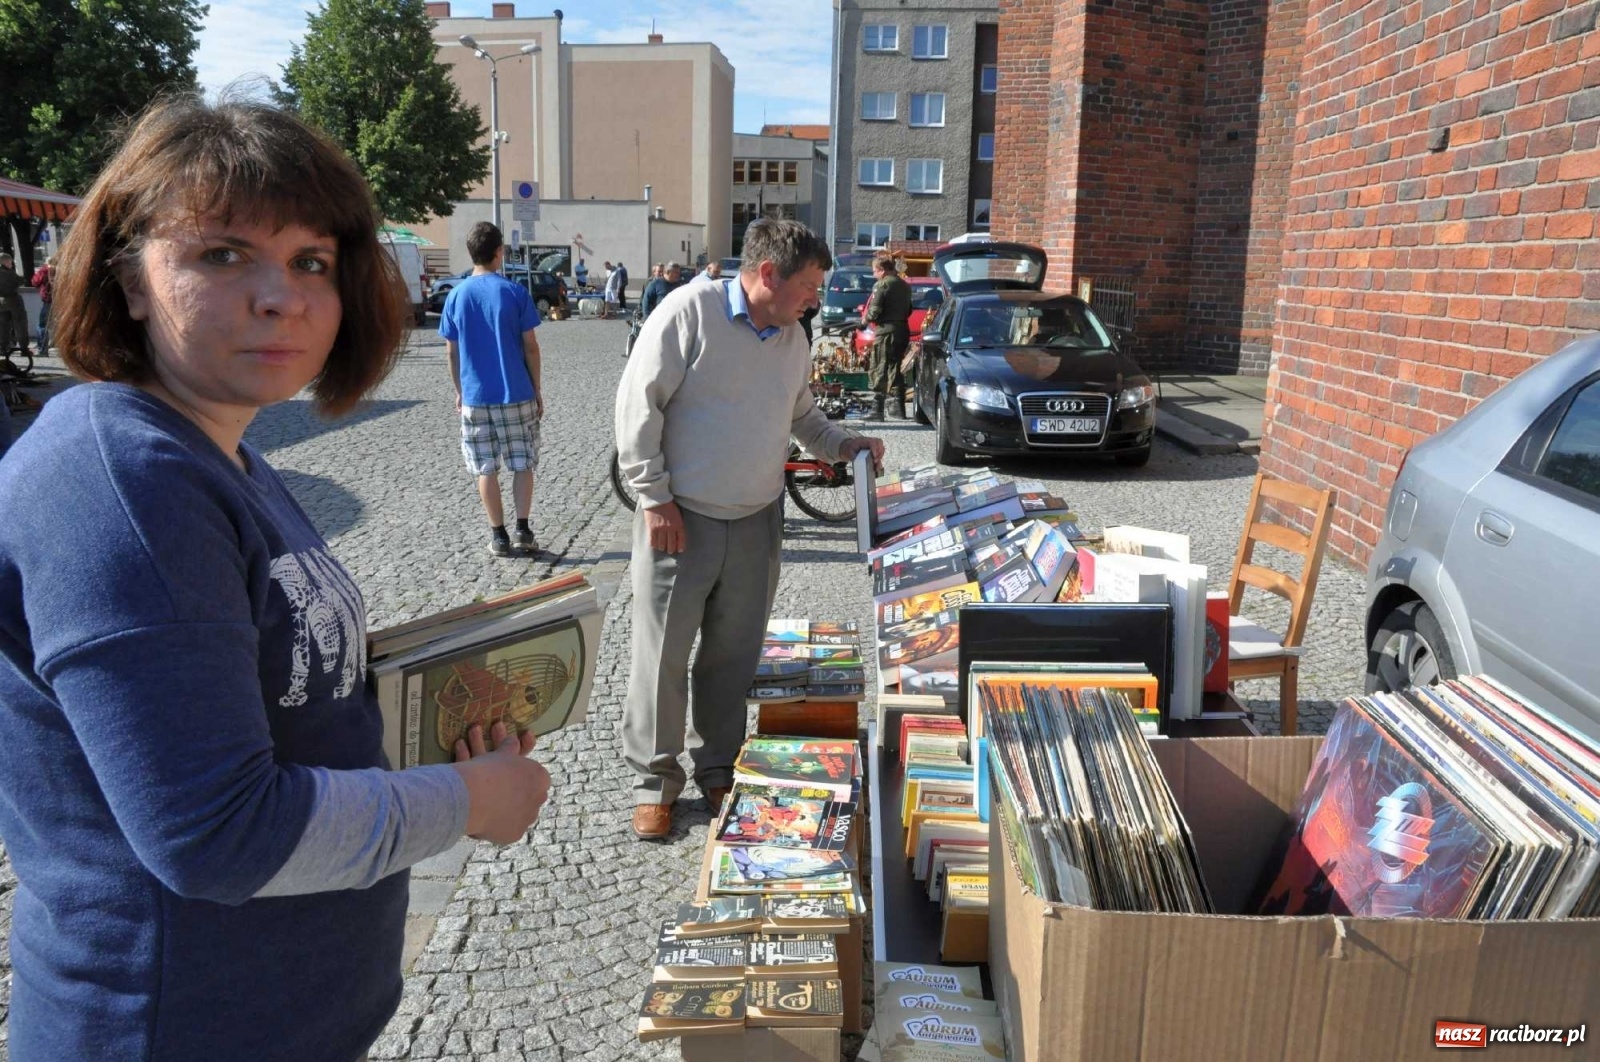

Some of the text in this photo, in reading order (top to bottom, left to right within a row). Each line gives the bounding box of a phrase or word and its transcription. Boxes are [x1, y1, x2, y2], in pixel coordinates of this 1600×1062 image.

[1039, 419, 1098, 432] SWD 42U2
[905, 973, 955, 983] AURUM
[920, 1024, 976, 1036] AURUM
